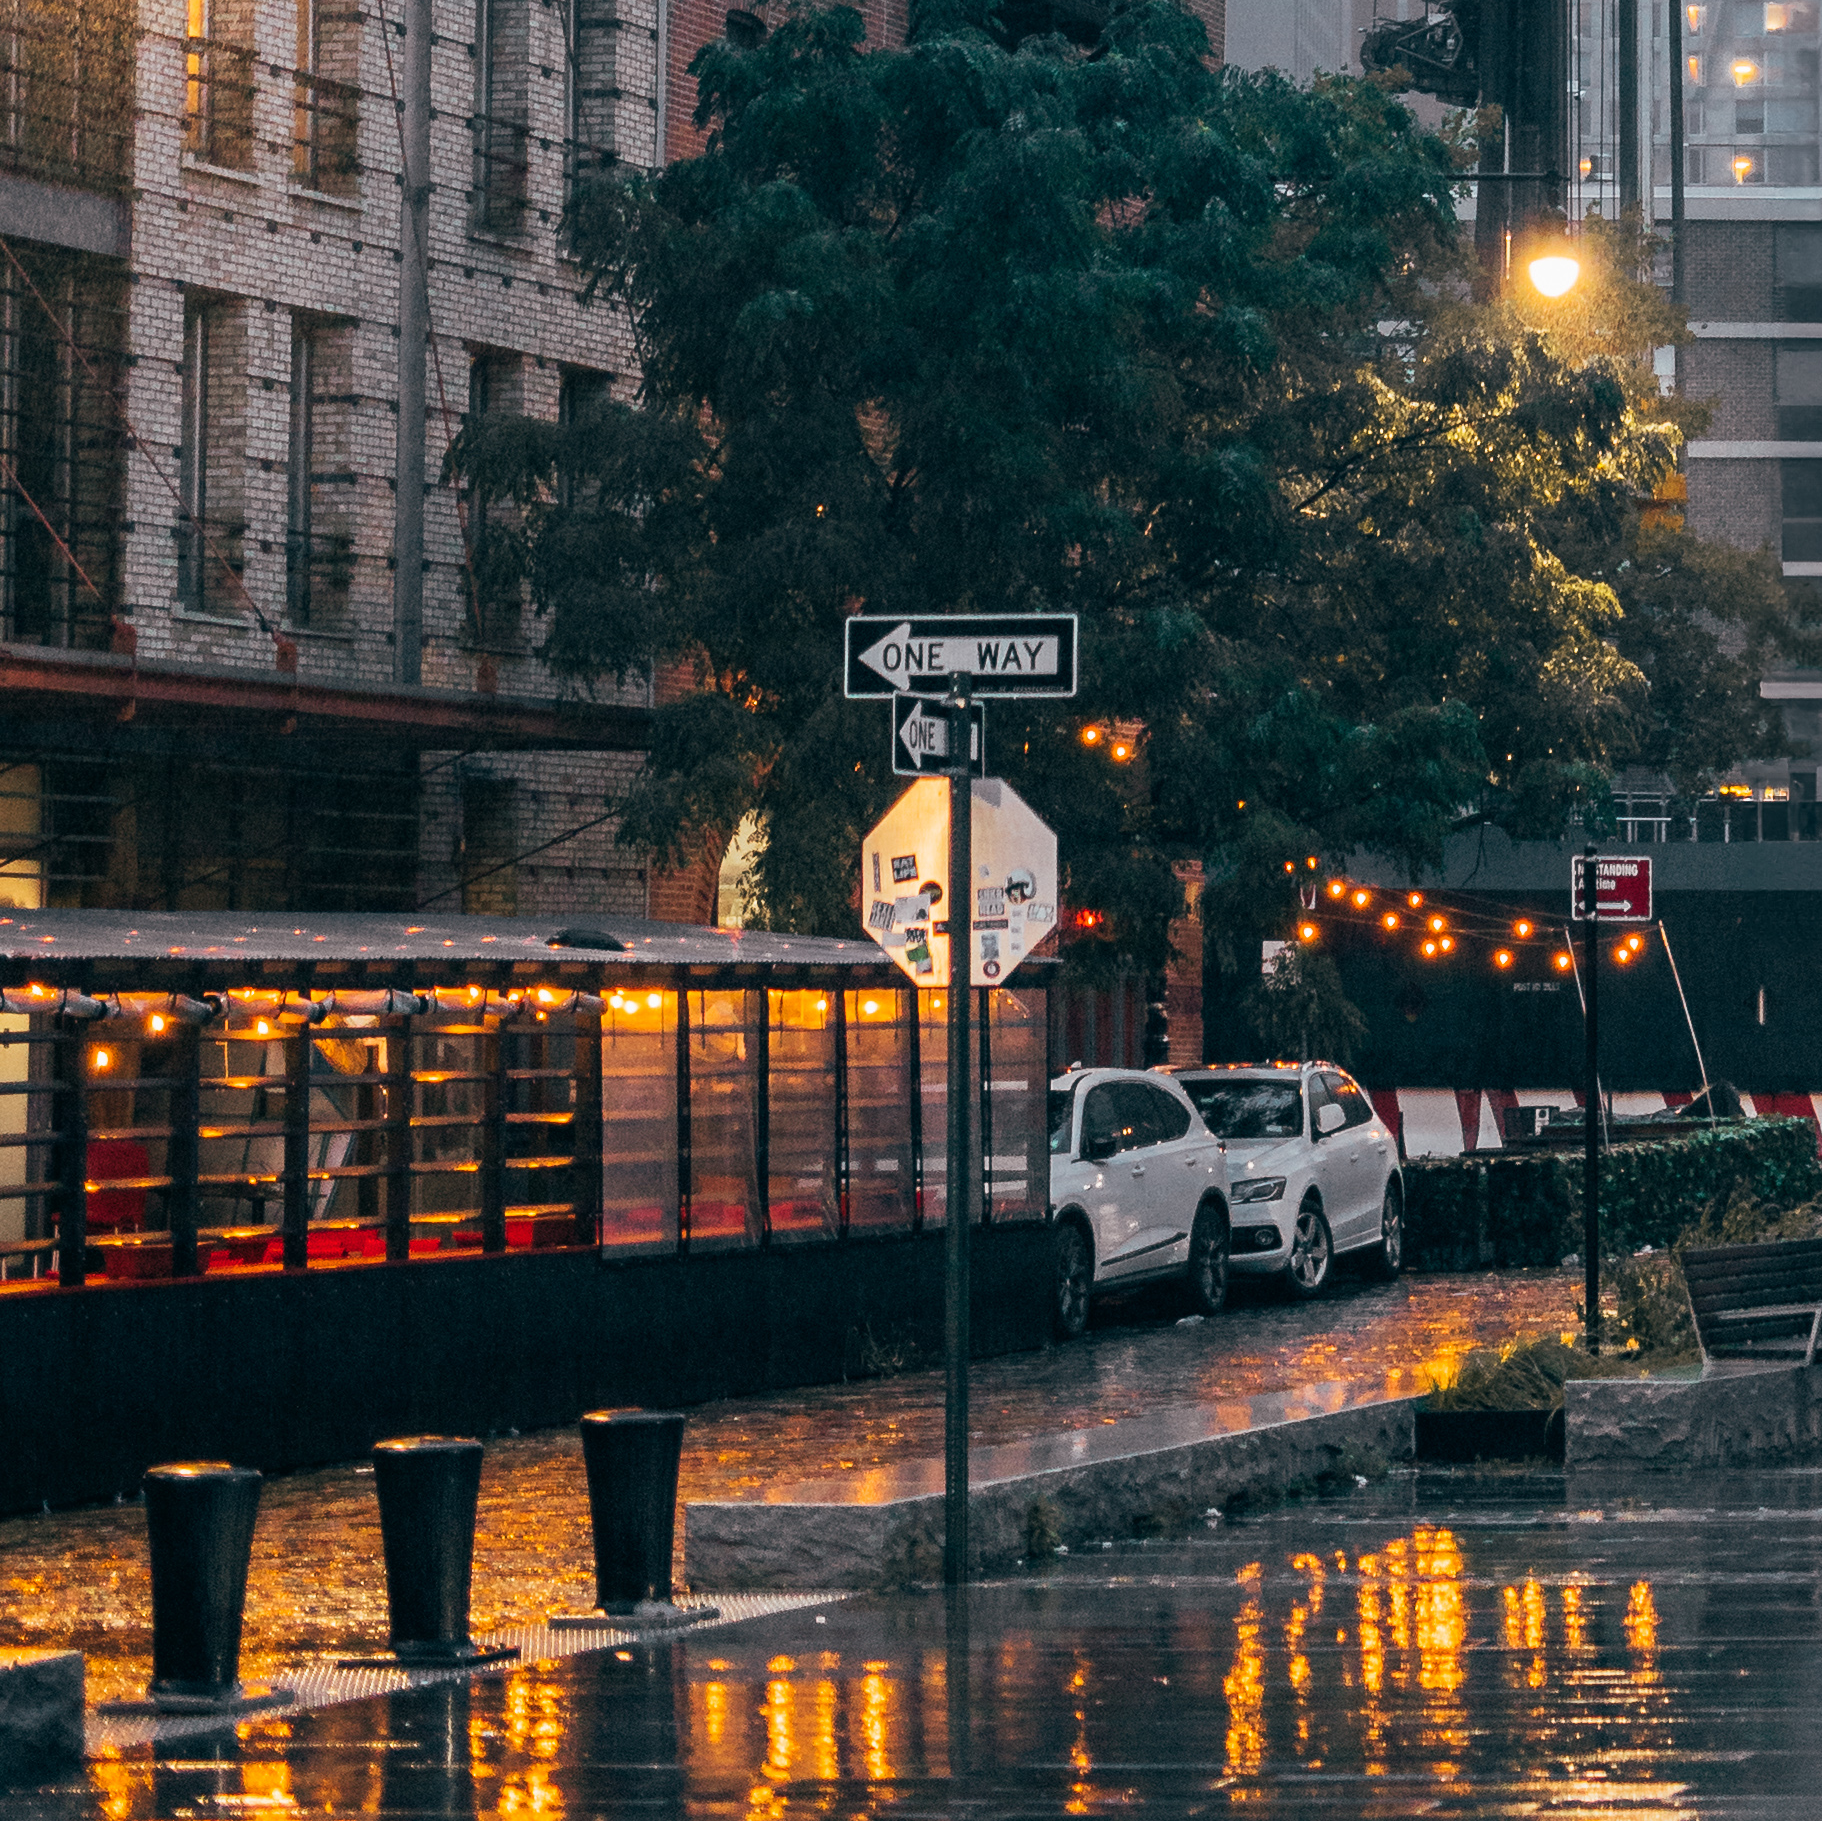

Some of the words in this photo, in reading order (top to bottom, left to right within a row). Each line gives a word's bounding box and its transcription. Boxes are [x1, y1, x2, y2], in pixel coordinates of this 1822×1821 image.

[883, 642, 944, 672] ONE
[977, 641, 1044, 671] WAY
[909, 721, 935, 751] ONE
[1579, 877, 1616, 890] Atime
